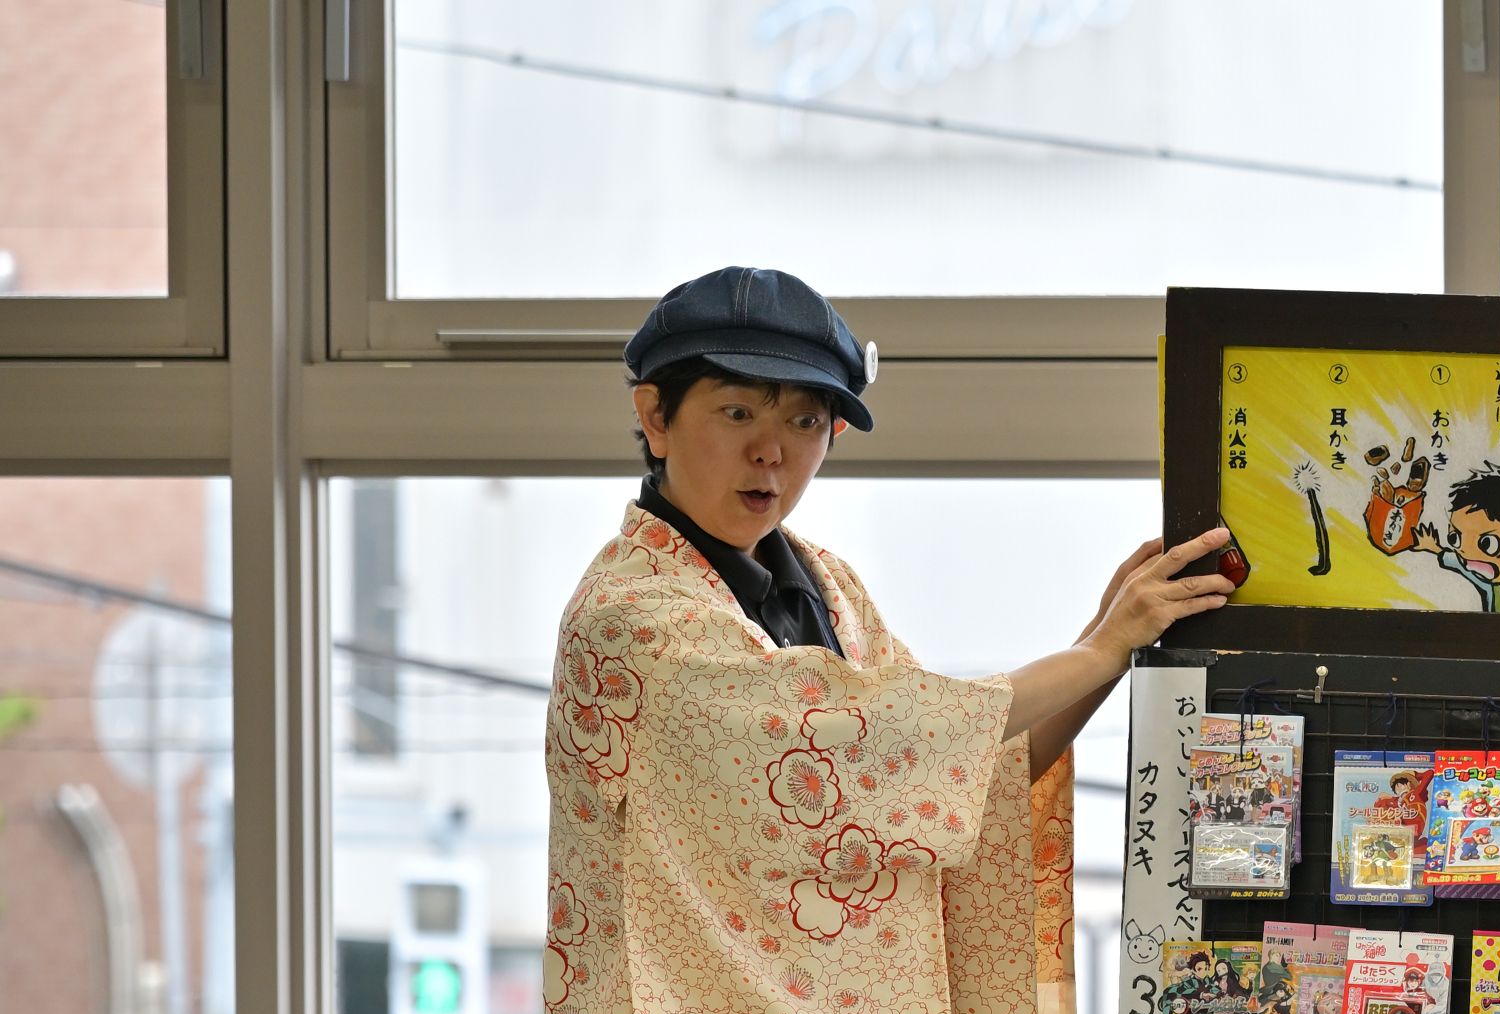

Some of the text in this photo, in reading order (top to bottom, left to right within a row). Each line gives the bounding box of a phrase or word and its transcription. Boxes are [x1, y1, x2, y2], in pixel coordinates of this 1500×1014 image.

[1228, 407, 1248, 470] 消火器
[1329, 408, 1349, 471] 耳かき
[1431, 409, 1450, 472] おかき
[1132, 761, 1160, 876] カタヌキ
[1348, 806, 1419, 819] シールコレクション
[1287, 950, 1345, 967] ステッカーコレクショ
[1359, 965, 1396, 977] はたらく
[1353, 976, 1399, 984] シールコレクション
